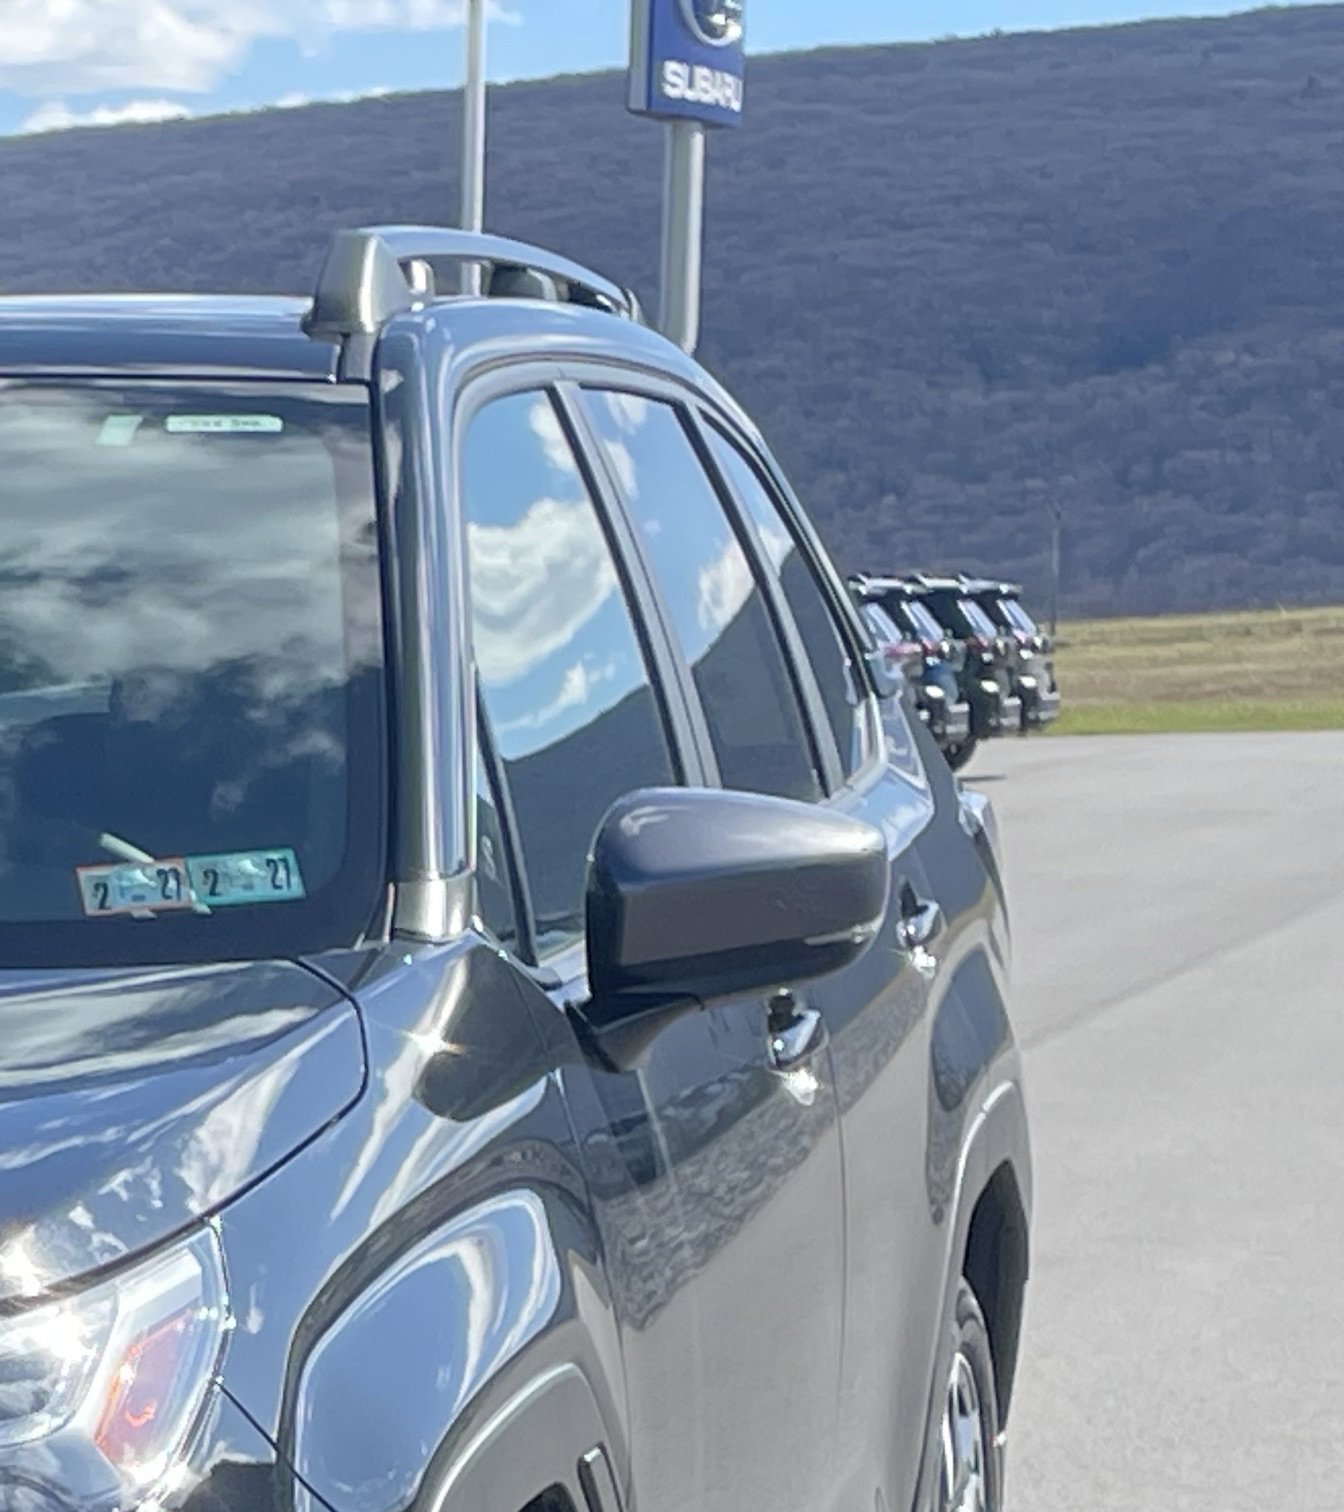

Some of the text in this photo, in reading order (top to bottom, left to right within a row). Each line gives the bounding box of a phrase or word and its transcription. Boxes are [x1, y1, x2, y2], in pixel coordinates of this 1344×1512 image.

[662, 59, 744, 113] SUBARU
[93, 867, 182, 910] 2 27
[202, 857, 292, 896] 2 27
